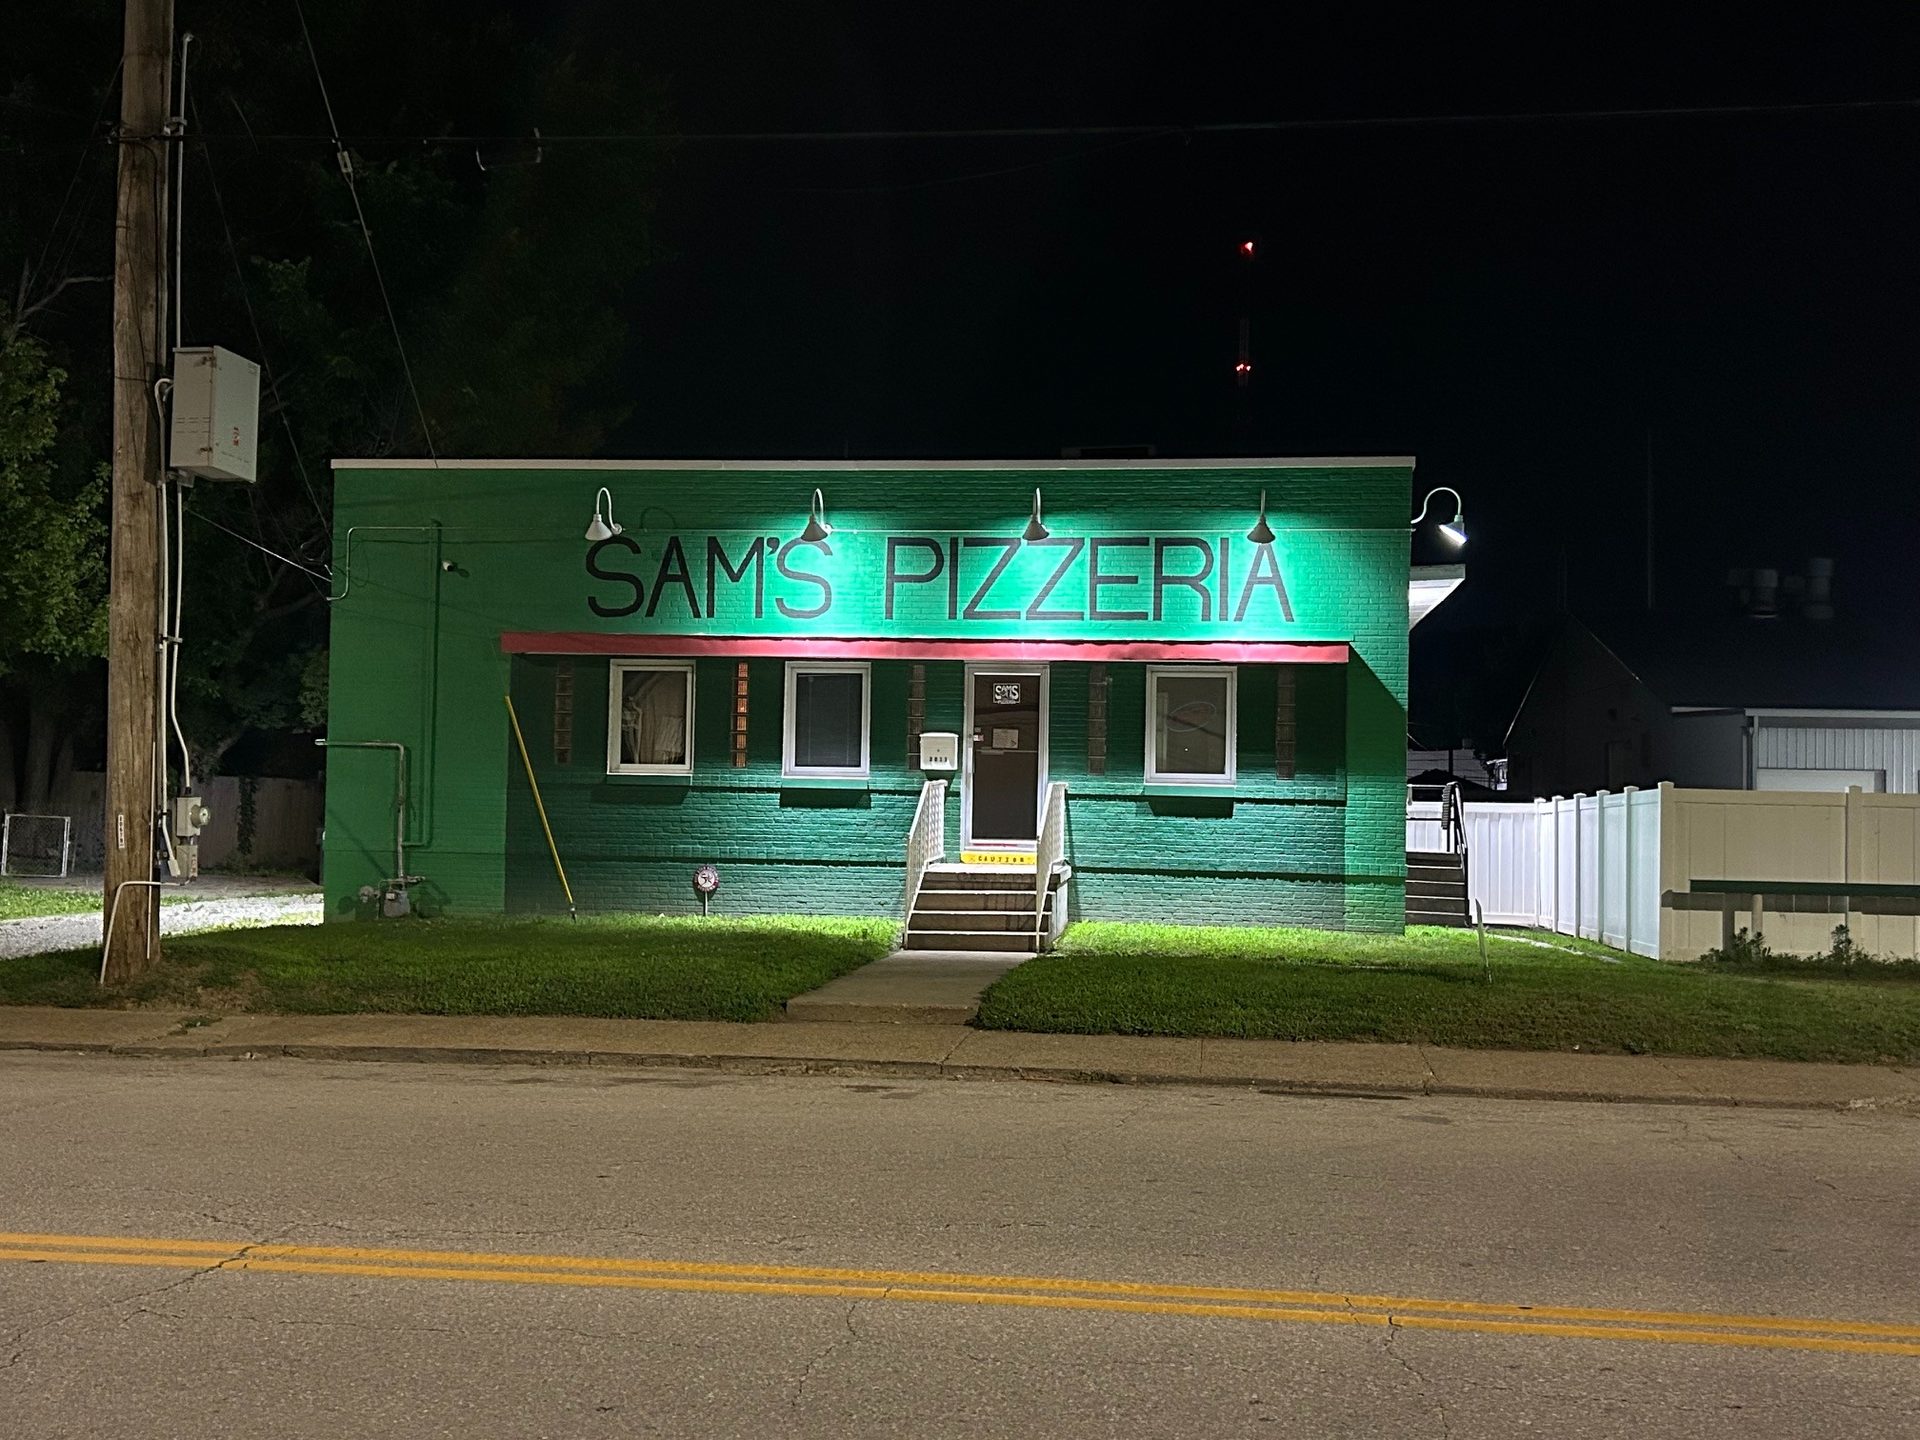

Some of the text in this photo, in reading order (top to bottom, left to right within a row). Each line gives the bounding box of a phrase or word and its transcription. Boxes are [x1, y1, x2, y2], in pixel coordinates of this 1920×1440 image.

[585, 536, 1294, 622] SAM'S PIZZERIA
[978, 855, 1024, 863] CAUTION
